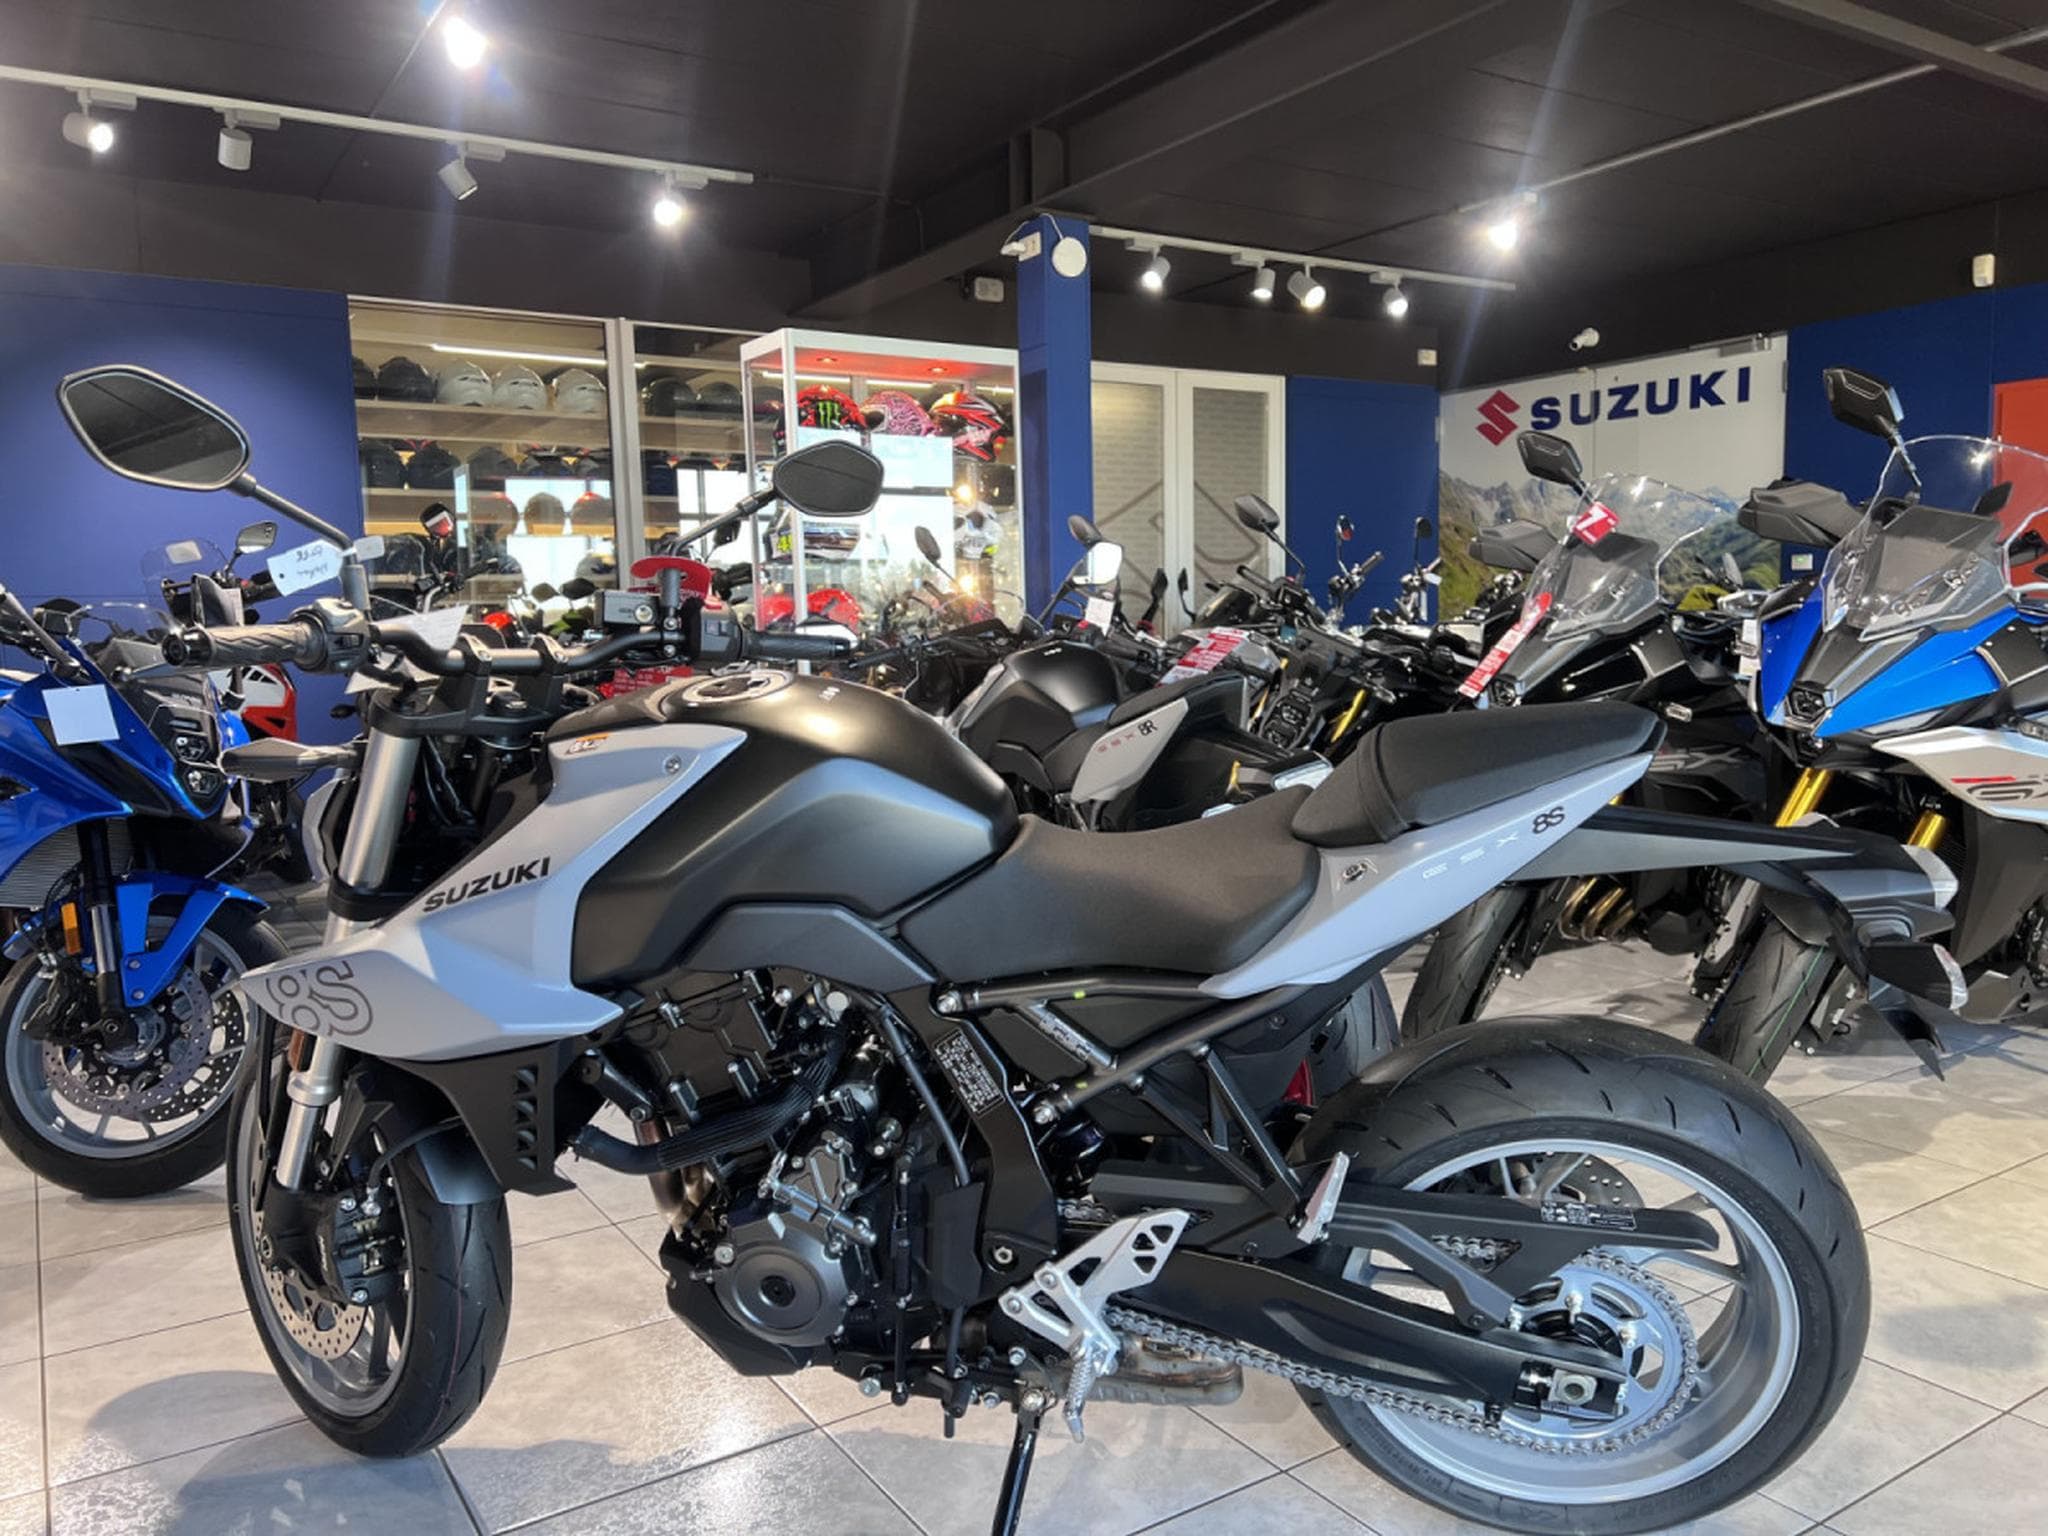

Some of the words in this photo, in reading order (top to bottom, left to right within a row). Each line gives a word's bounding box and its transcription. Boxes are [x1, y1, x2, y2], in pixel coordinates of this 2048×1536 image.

[1531, 366, 1751, 431] SUZUKI
[1532, 805, 1566, 835] 8S
[422, 856, 552, 913] SUZUKI
[265, 959, 374, 1036] 8S
